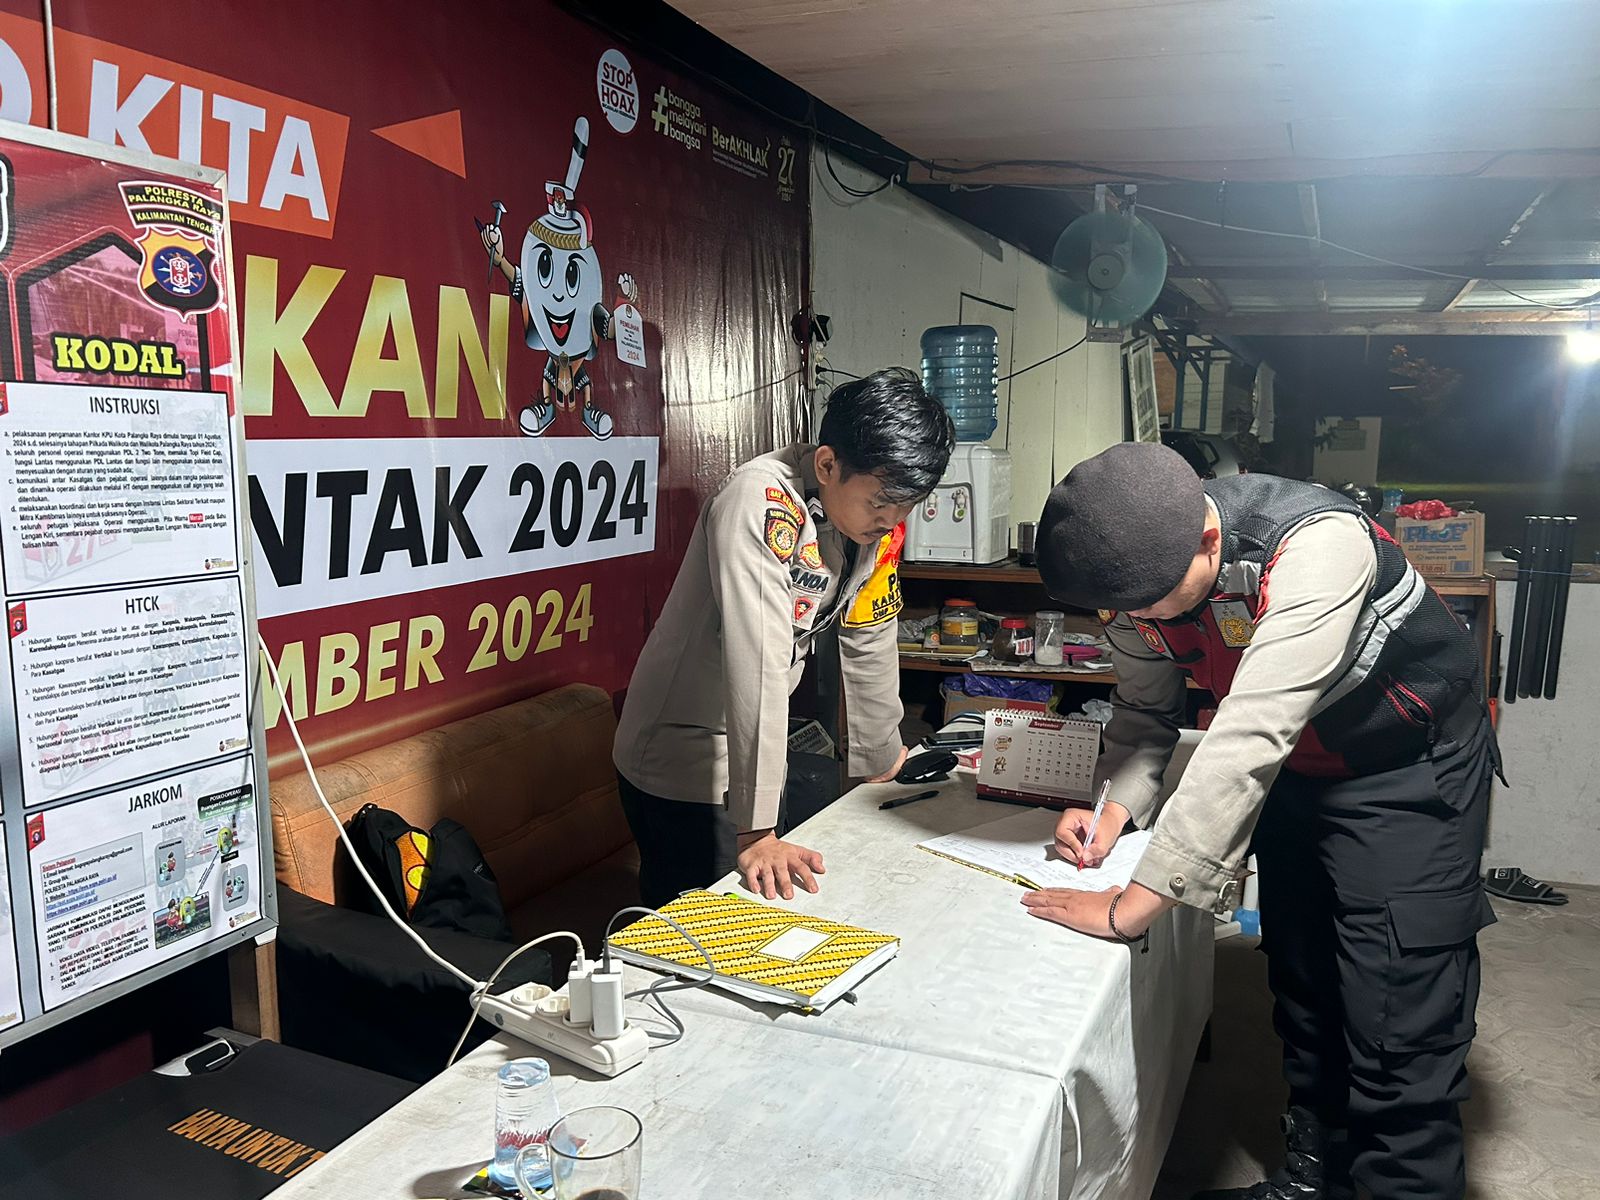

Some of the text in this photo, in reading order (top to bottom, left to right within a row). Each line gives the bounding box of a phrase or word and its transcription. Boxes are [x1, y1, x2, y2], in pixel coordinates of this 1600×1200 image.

[602, 62, 633, 88] STOP
[601, 85, 635, 115] HOAX
[668, 90, 701, 119] bangga
[669, 110, 707, 136] melayani
[88, 59, 329, 221] KITA
[669, 124, 701, 150] bangsa
[712, 127, 768, 168] BerAKHLAK
[778, 147, 796, 185] 27
[144, 186, 203, 206] POLRESTA
[128, 195, 220, 220] PALANGKA RAYA
[135, 212, 184, 223] KALIMANTAN
[54, 336, 183, 376] KODAL
[89, 396, 160, 415] INSTRUKSI
[56, 467, 76, 475] dengan
[508, 460, 648, 554] 2024
[125, 596, 159, 614] HTCK
[466, 583, 595, 674] 2024
[29, 637, 52, 646] Hubungan
[30, 661, 54, 670] Hubungan
[32, 685, 55, 694] Hubungan
[35, 709, 57, 718] Hubungan
[1034, 721, 1059, 729] September
[37, 732, 59, 741] Hubungan
[39, 756, 61, 766] Hubungan
[62, 760, 78, 768] dengan
[128, 784, 182, 813] JARKOM
[152, 816, 186, 830] ALUR LAPORAN
[45, 884, 66, 895] POLRESTA
[167, 1109, 251, 1150] HANYA
[223, 1128, 315, 1174] UNTUK
